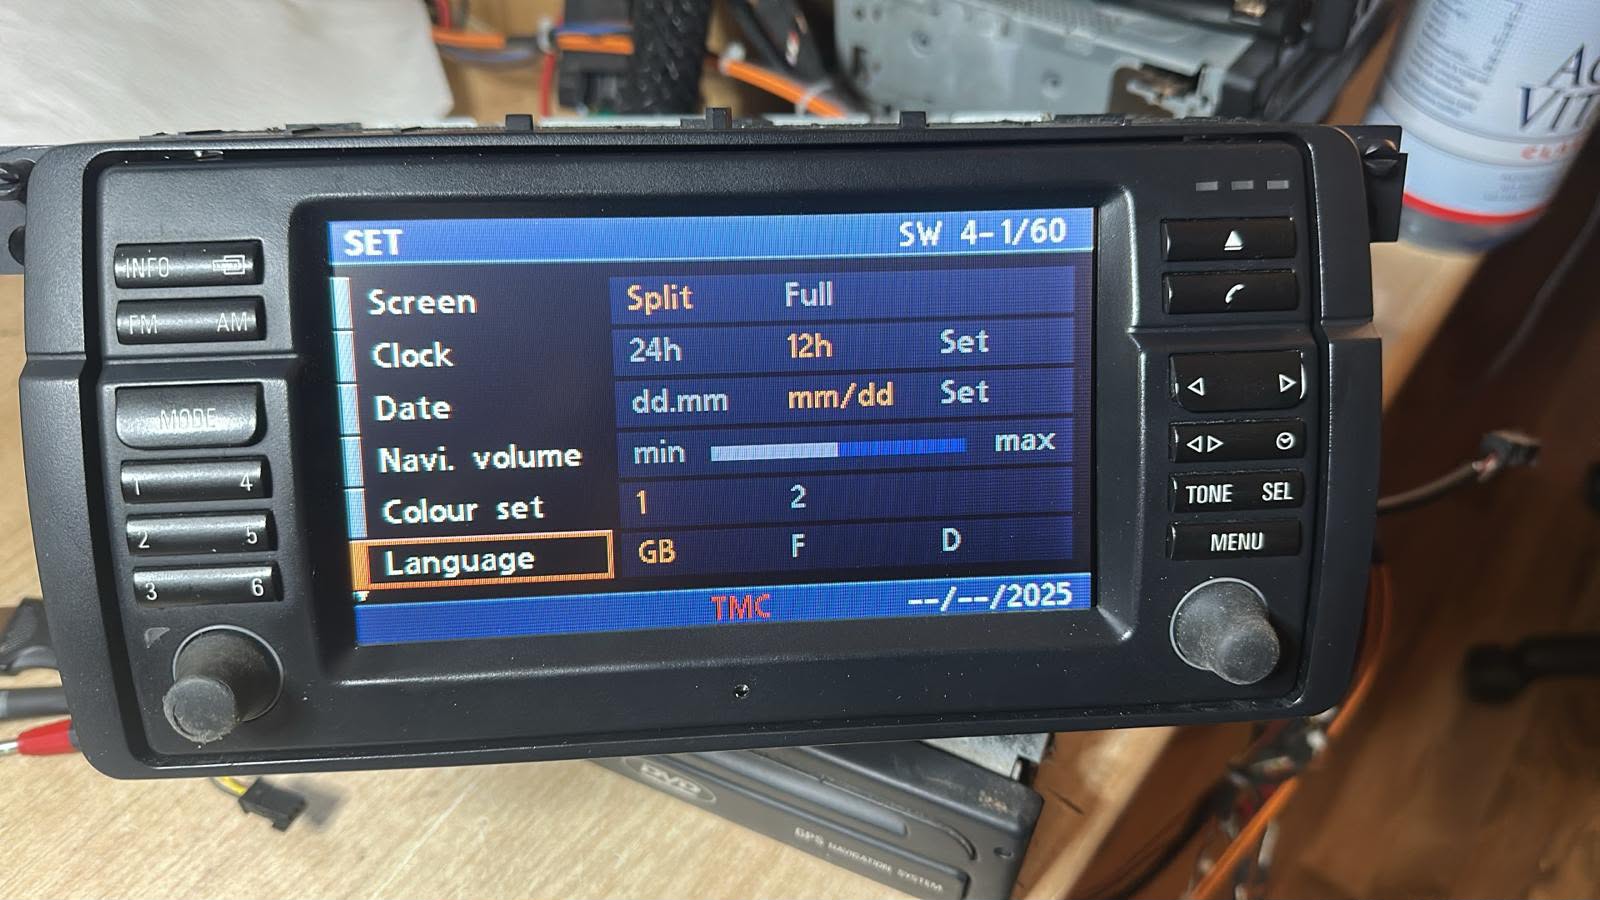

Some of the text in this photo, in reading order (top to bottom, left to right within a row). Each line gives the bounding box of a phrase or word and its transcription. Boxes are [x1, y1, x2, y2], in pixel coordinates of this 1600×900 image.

[344, 229, 403, 256] SET
[900, 220, 942, 247] SW
[126, 257, 169, 278] INFO
[368, 289, 477, 315] Screen
[627, 284, 694, 315] Split
[785, 281, 833, 307] Full
[129, 314, 158, 335] FM
[217, 312, 248, 333] AM
[628, 337, 683, 363] 24h
[787, 333, 833, 358] 12h
[940, 329, 989, 354] Set
[373, 341, 454, 369] Clock
[632, 388, 729, 414] dd.mm
[788, 381, 894, 409] mm/dd
[940, 379, 989, 404] Set
[160, 407, 216, 430] MODE
[375, 395, 451, 422] Date
[634, 439, 686, 465] min
[995, 432, 1056, 452] max
[378, 443, 582, 474] Navi. volume
[134, 475, 141, 495] 1
[240, 474, 253, 492] 4
[1186, 484, 1233, 504] TONE
[1262, 482, 1294, 501] SEL
[636, 490, 647, 515] 1
[790, 484, 807, 509] 2
[382, 496, 545, 525] Colour set
[138, 530, 150, 549] 2
[246, 526, 258, 544] 5
[791, 533, 805, 558] F
[942, 527, 961, 552] D
[1211, 532, 1264, 552] MENU
[384, 549, 536, 578] Language
[638, 538, 677, 565] GB
[146, 581, 158, 600] 3
[251, 578, 264, 596] 6
[711, 593, 771, 622] TMC
[641, 763, 701, 796] DVD
[794, 827, 824, 846] GPS
